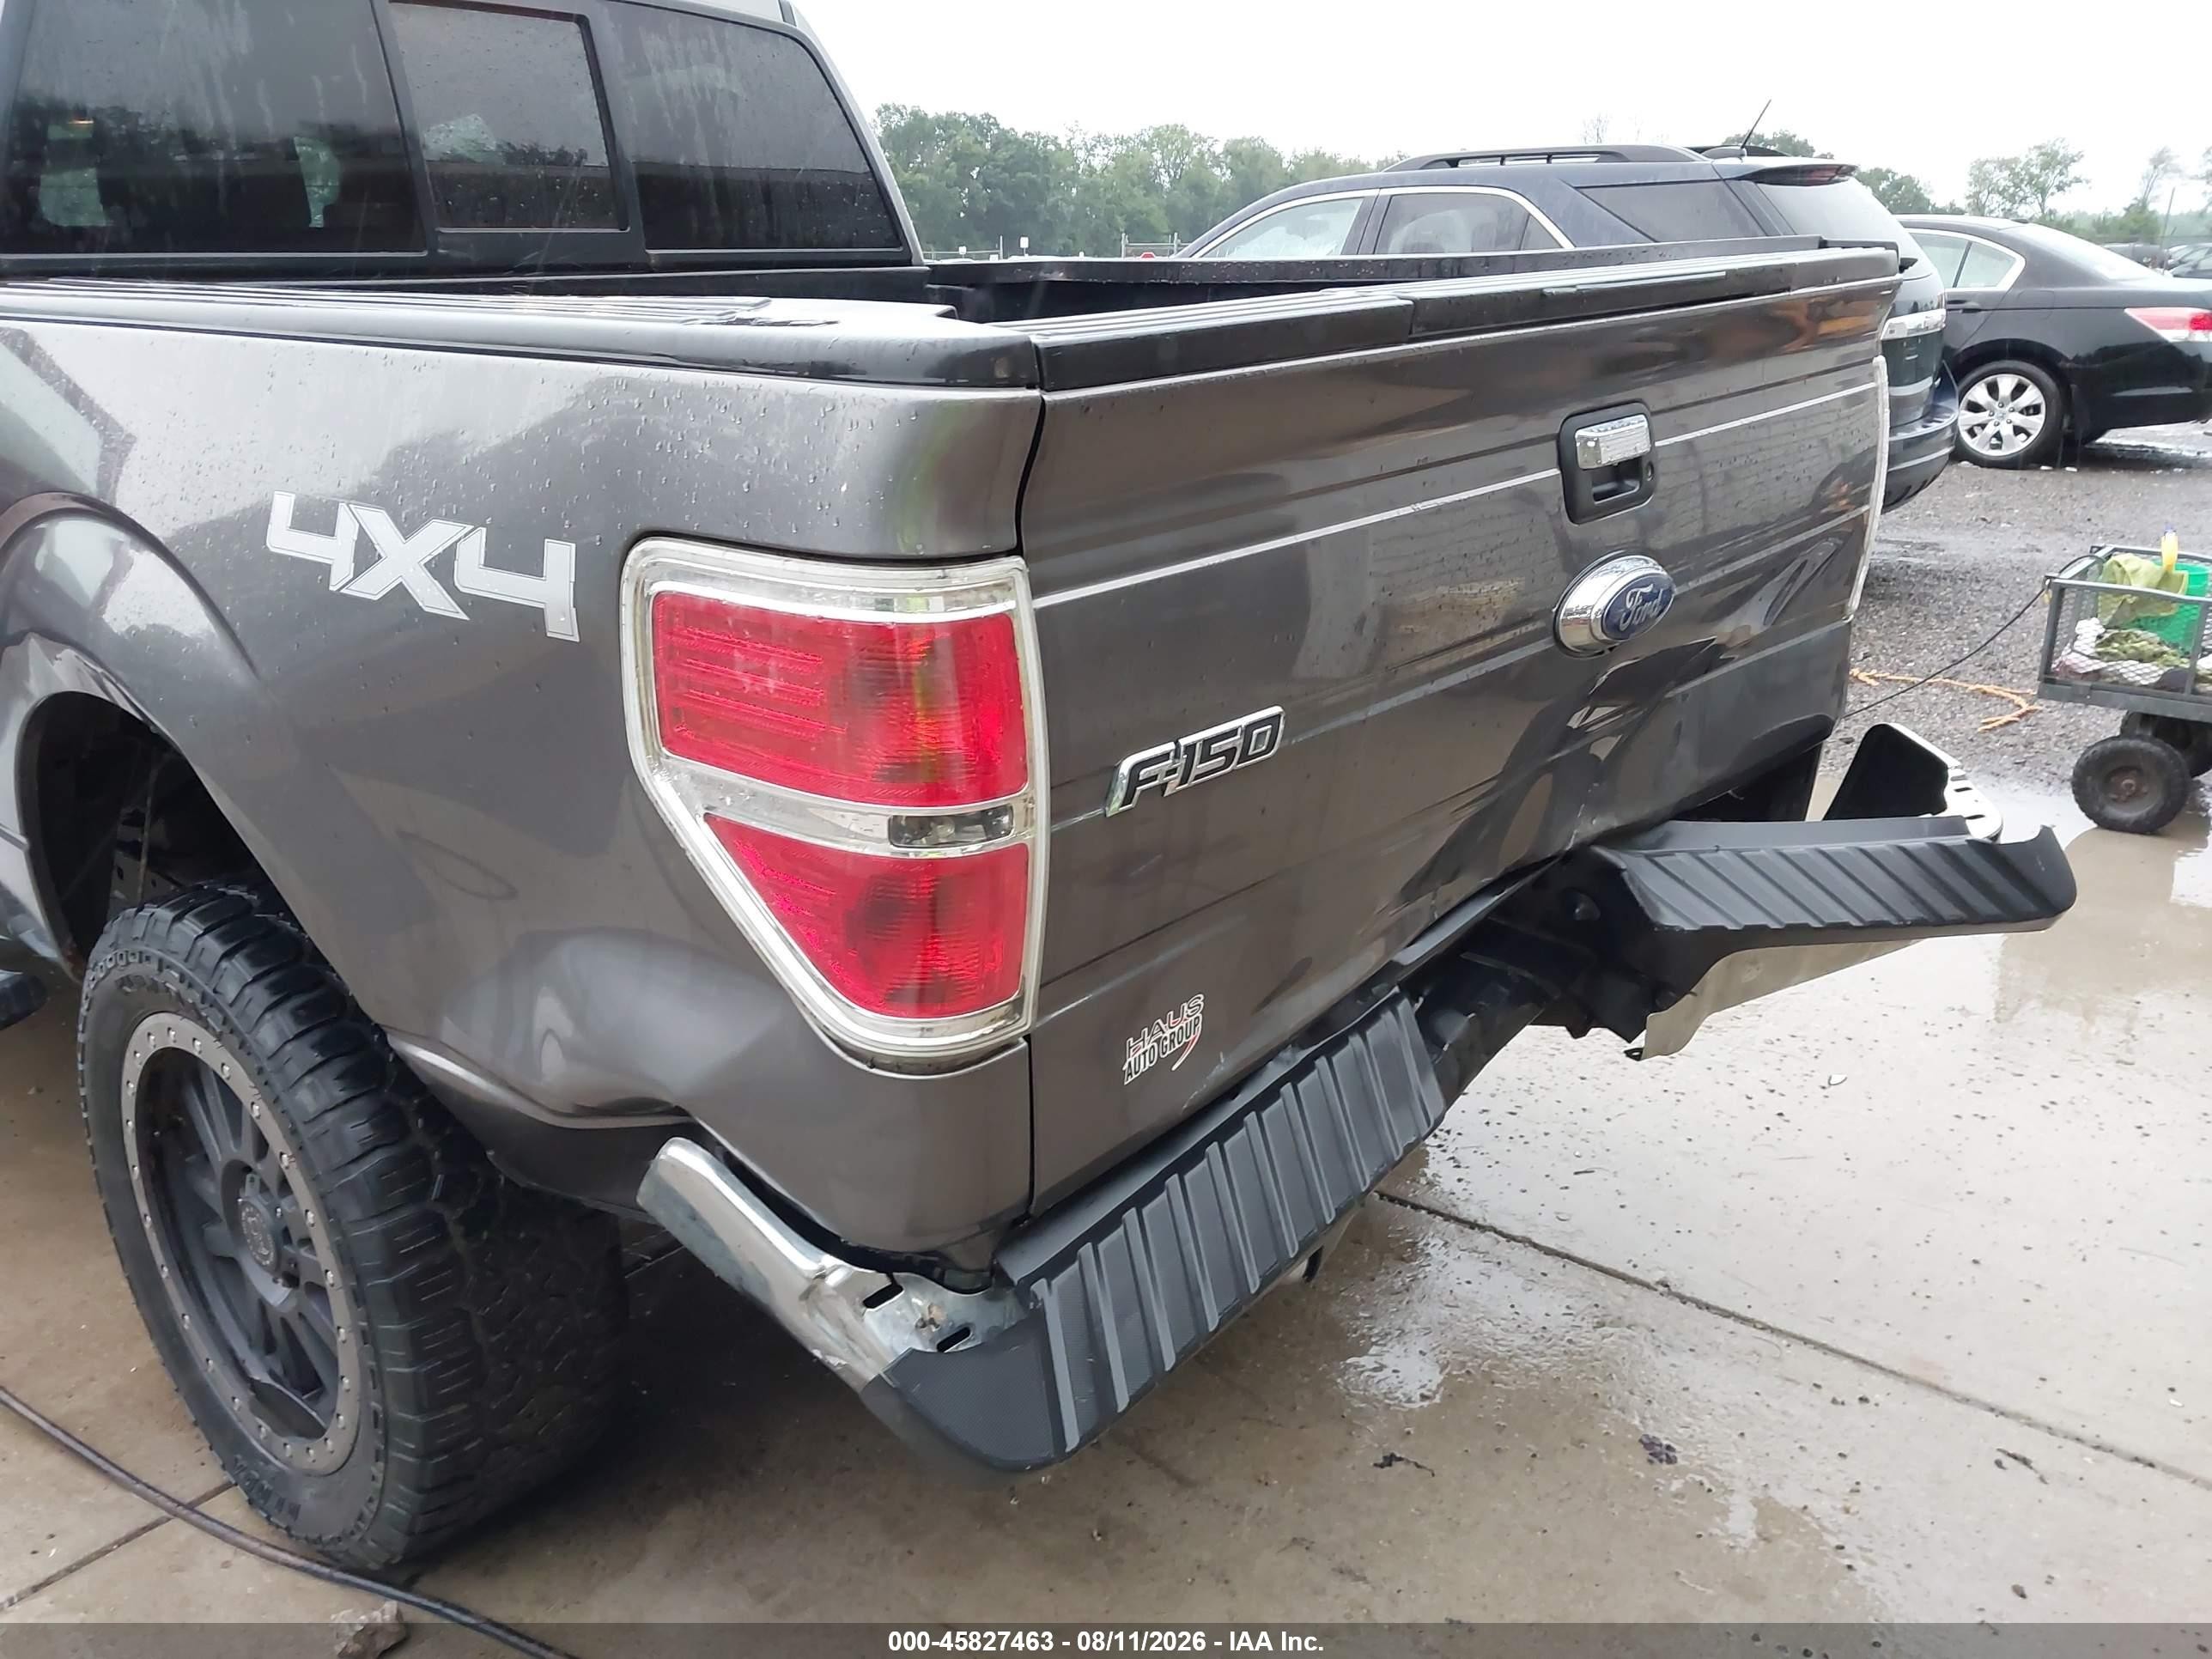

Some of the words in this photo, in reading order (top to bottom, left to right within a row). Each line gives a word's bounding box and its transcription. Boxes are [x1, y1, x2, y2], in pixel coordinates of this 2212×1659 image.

[1620, 583, 1663, 631] Ford
[1105, 705, 1285, 817] F-150
[1123, 1042, 1158, 1085] AUTO
[1159, 1013, 1202, 1058] GROUP
[1126, 994, 1204, 1060] HAUS
